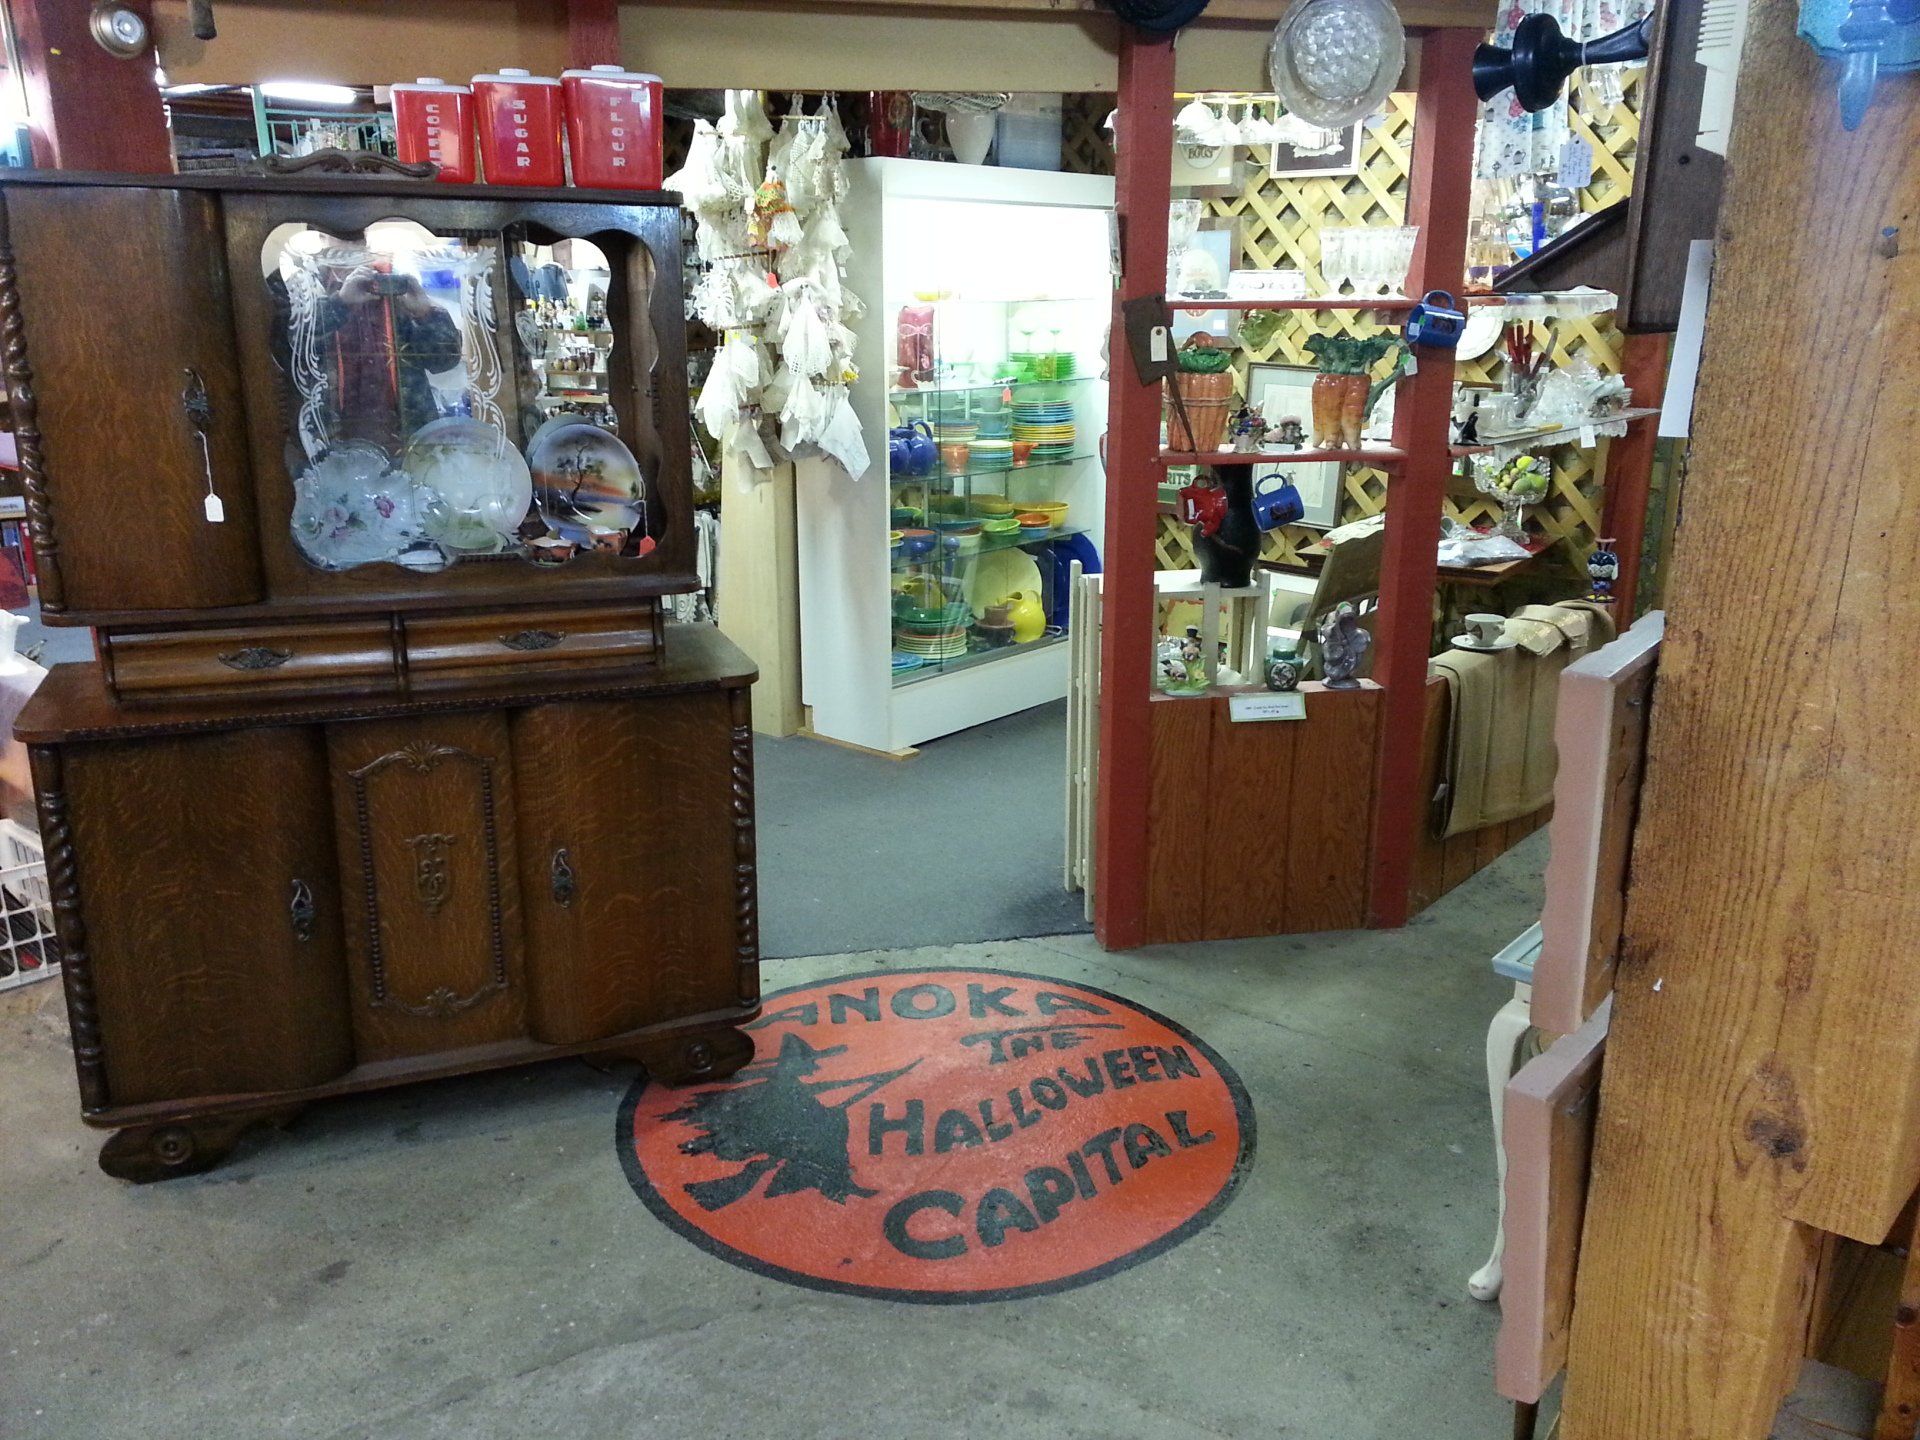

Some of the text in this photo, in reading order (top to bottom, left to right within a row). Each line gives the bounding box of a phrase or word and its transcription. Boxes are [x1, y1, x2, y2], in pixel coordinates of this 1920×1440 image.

[511, 99, 531, 167] SUGAR
[609, 96, 626, 167] FLOUR
[744, 983, 1111, 1030] ANOKA
[960, 1023, 1125, 1065] THE
[868, 1045, 1201, 1156] HALLOWEEN
[883, 1110, 1216, 1260] CAPITAL
